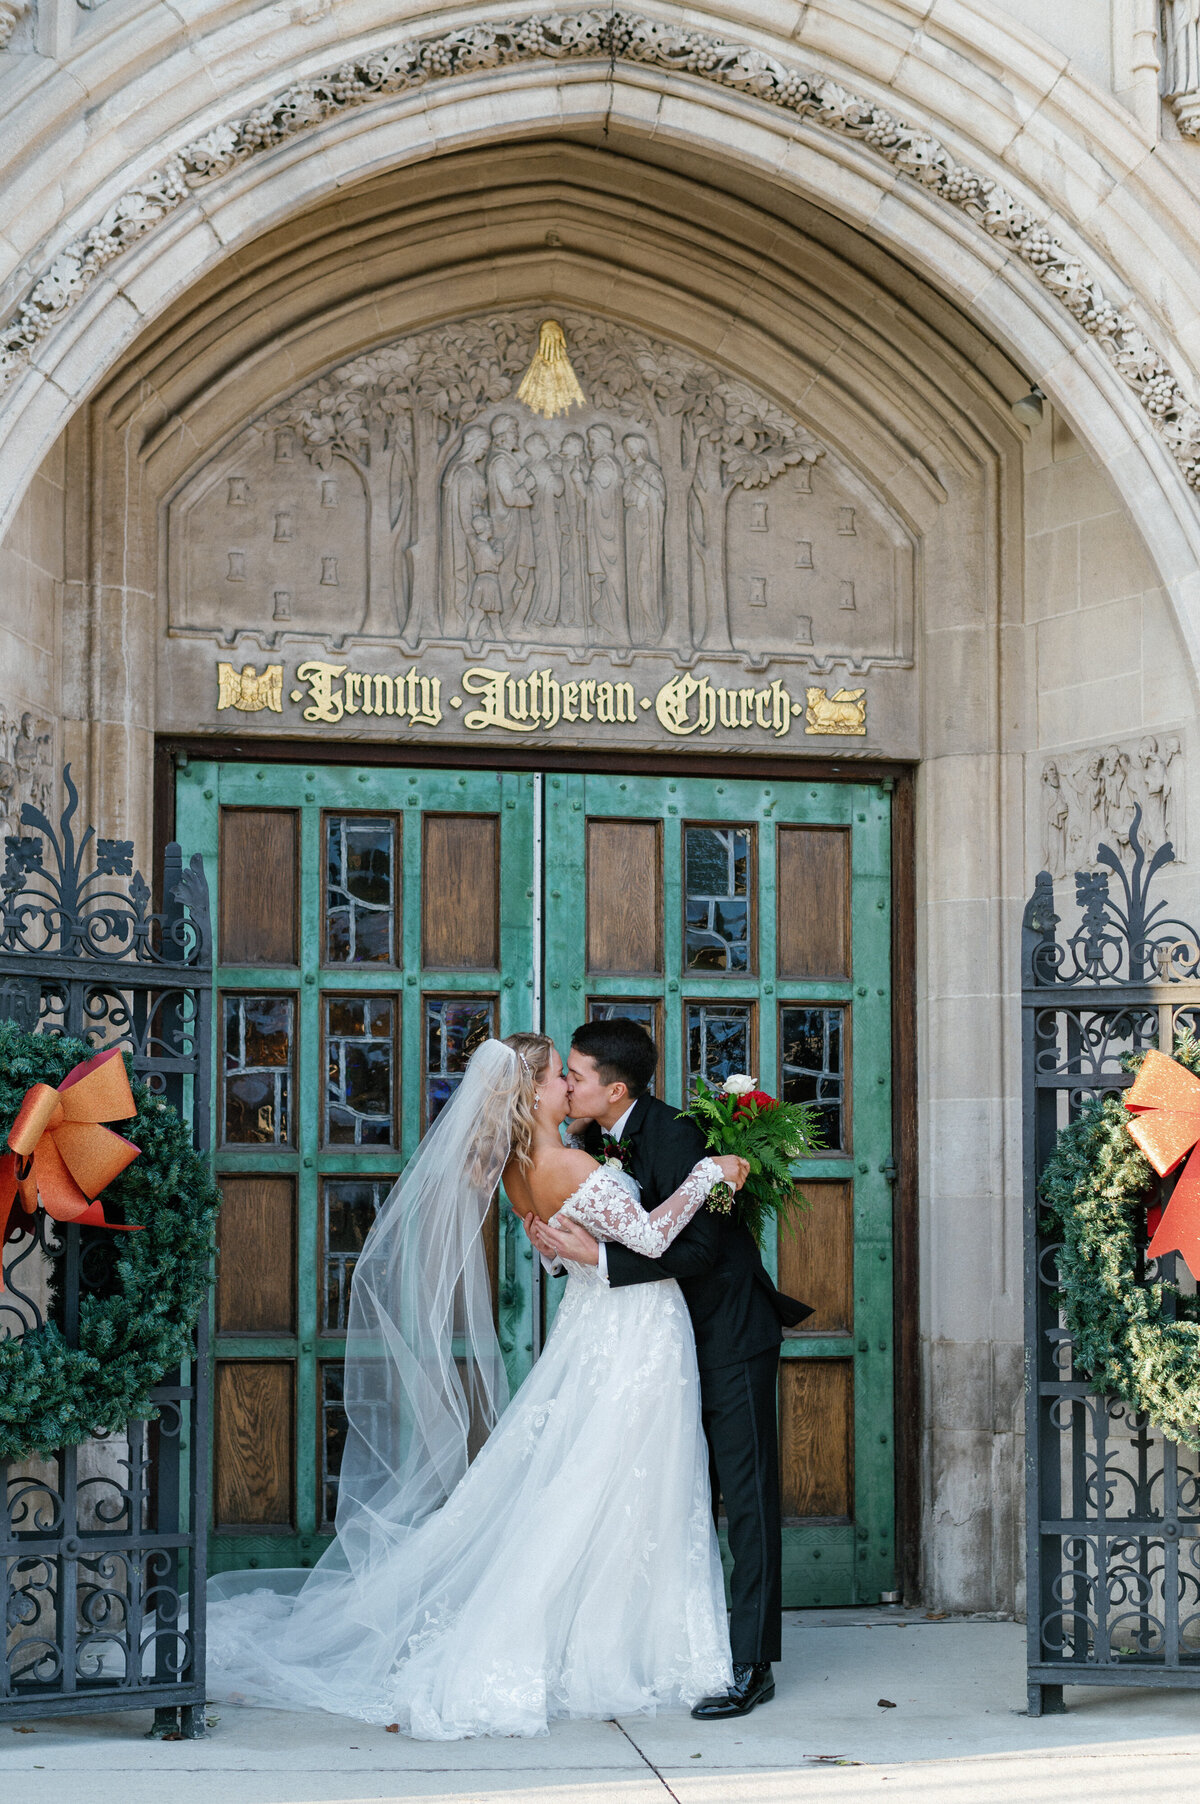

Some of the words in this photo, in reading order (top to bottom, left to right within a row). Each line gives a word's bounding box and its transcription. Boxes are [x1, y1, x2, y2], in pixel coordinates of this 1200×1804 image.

[296, 660, 442, 727] Trinity
[462, 666, 638, 732] Lutheran
[655, 671, 791, 738] Church
